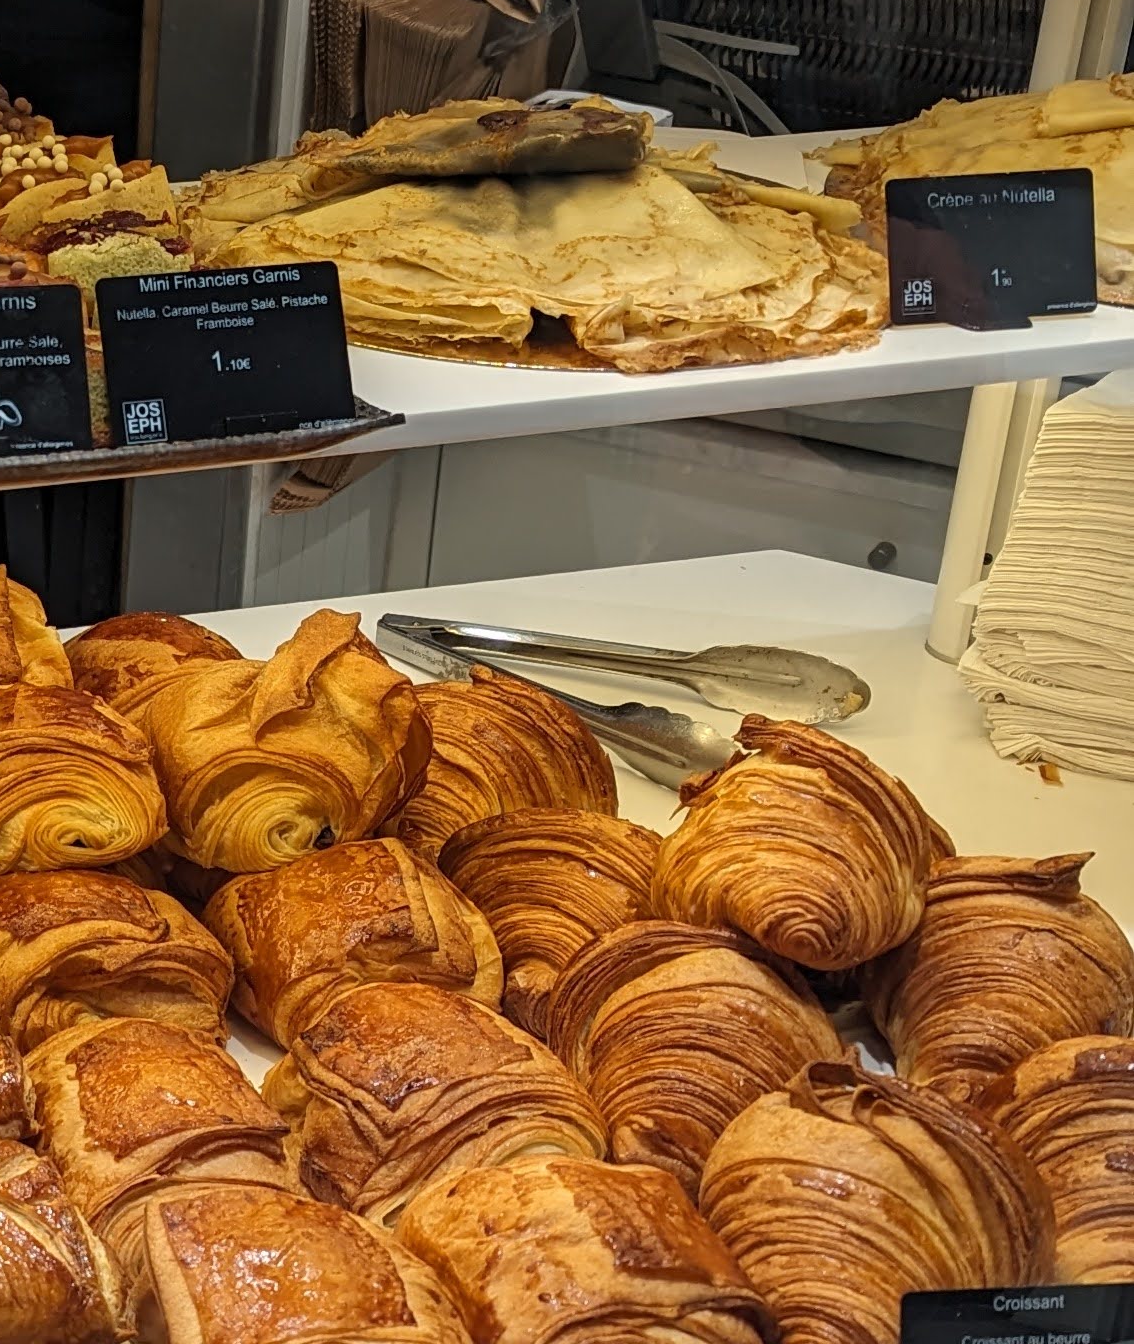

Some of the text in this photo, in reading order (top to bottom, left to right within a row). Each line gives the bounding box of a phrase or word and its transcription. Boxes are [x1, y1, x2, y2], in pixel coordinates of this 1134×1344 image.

[1002, 187, 1056, 204] Nutella
[139, 266, 301, 293] Mini Financiers Garnis
[904, 280, 933, 294] JOS
[162, 304, 209, 319] Caramel
[212, 300, 249, 315] Beurre
[281, 293, 328, 309] Pistache
[904, 293, 933, 307] EPH
[196, 315, 255, 331] Framboise
[212, 350, 251, 373] 1.10€
[127, 402, 162, 419] JOS
[128, 418, 163, 435] EPH
[993, 1294, 1065, 1312] Croissant
